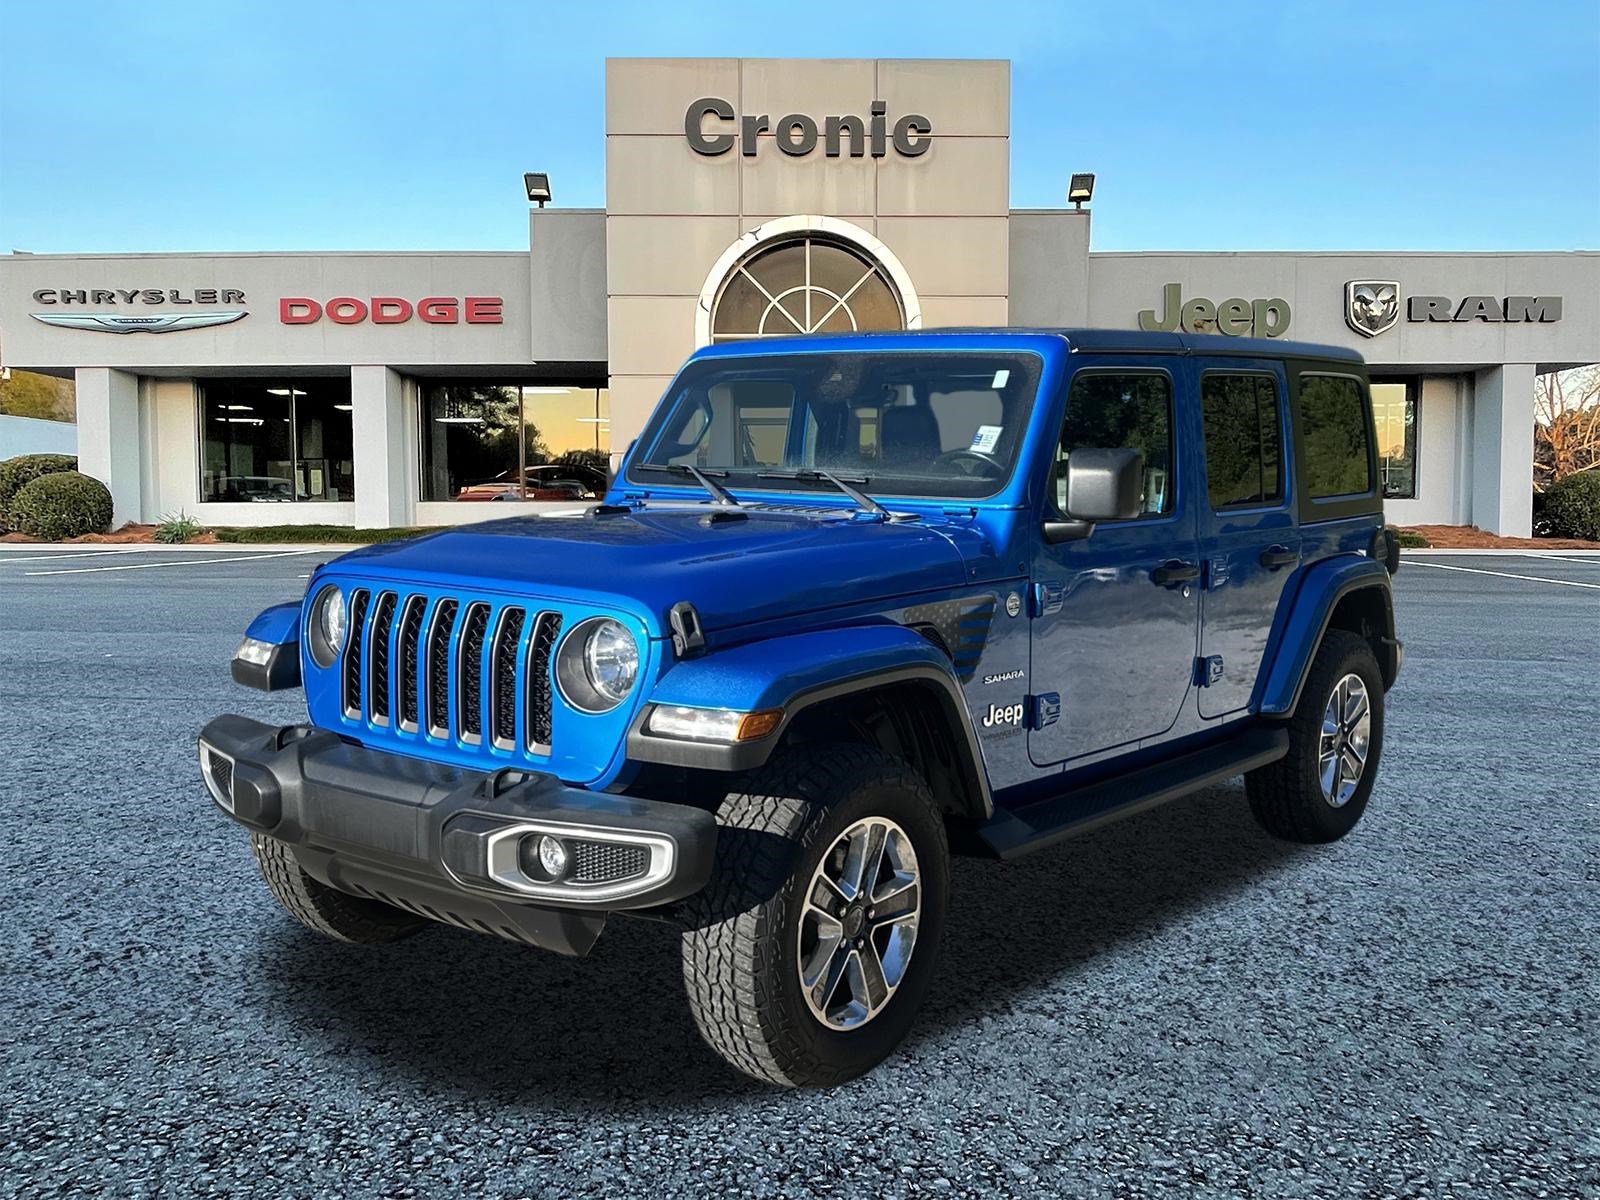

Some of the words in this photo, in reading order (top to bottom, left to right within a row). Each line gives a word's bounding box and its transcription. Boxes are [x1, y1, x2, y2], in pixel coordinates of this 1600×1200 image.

[685, 97, 932, 157] Cronic
[32, 289, 248, 305] CHRYSLER
[1407, 296, 1563, 322] RAM
[280, 297, 503, 325] DODGE
[1138, 283, 1292, 339] Jeep
[983, 670, 1025, 685] SAHARA
[983, 703, 1024, 727] Jeep
